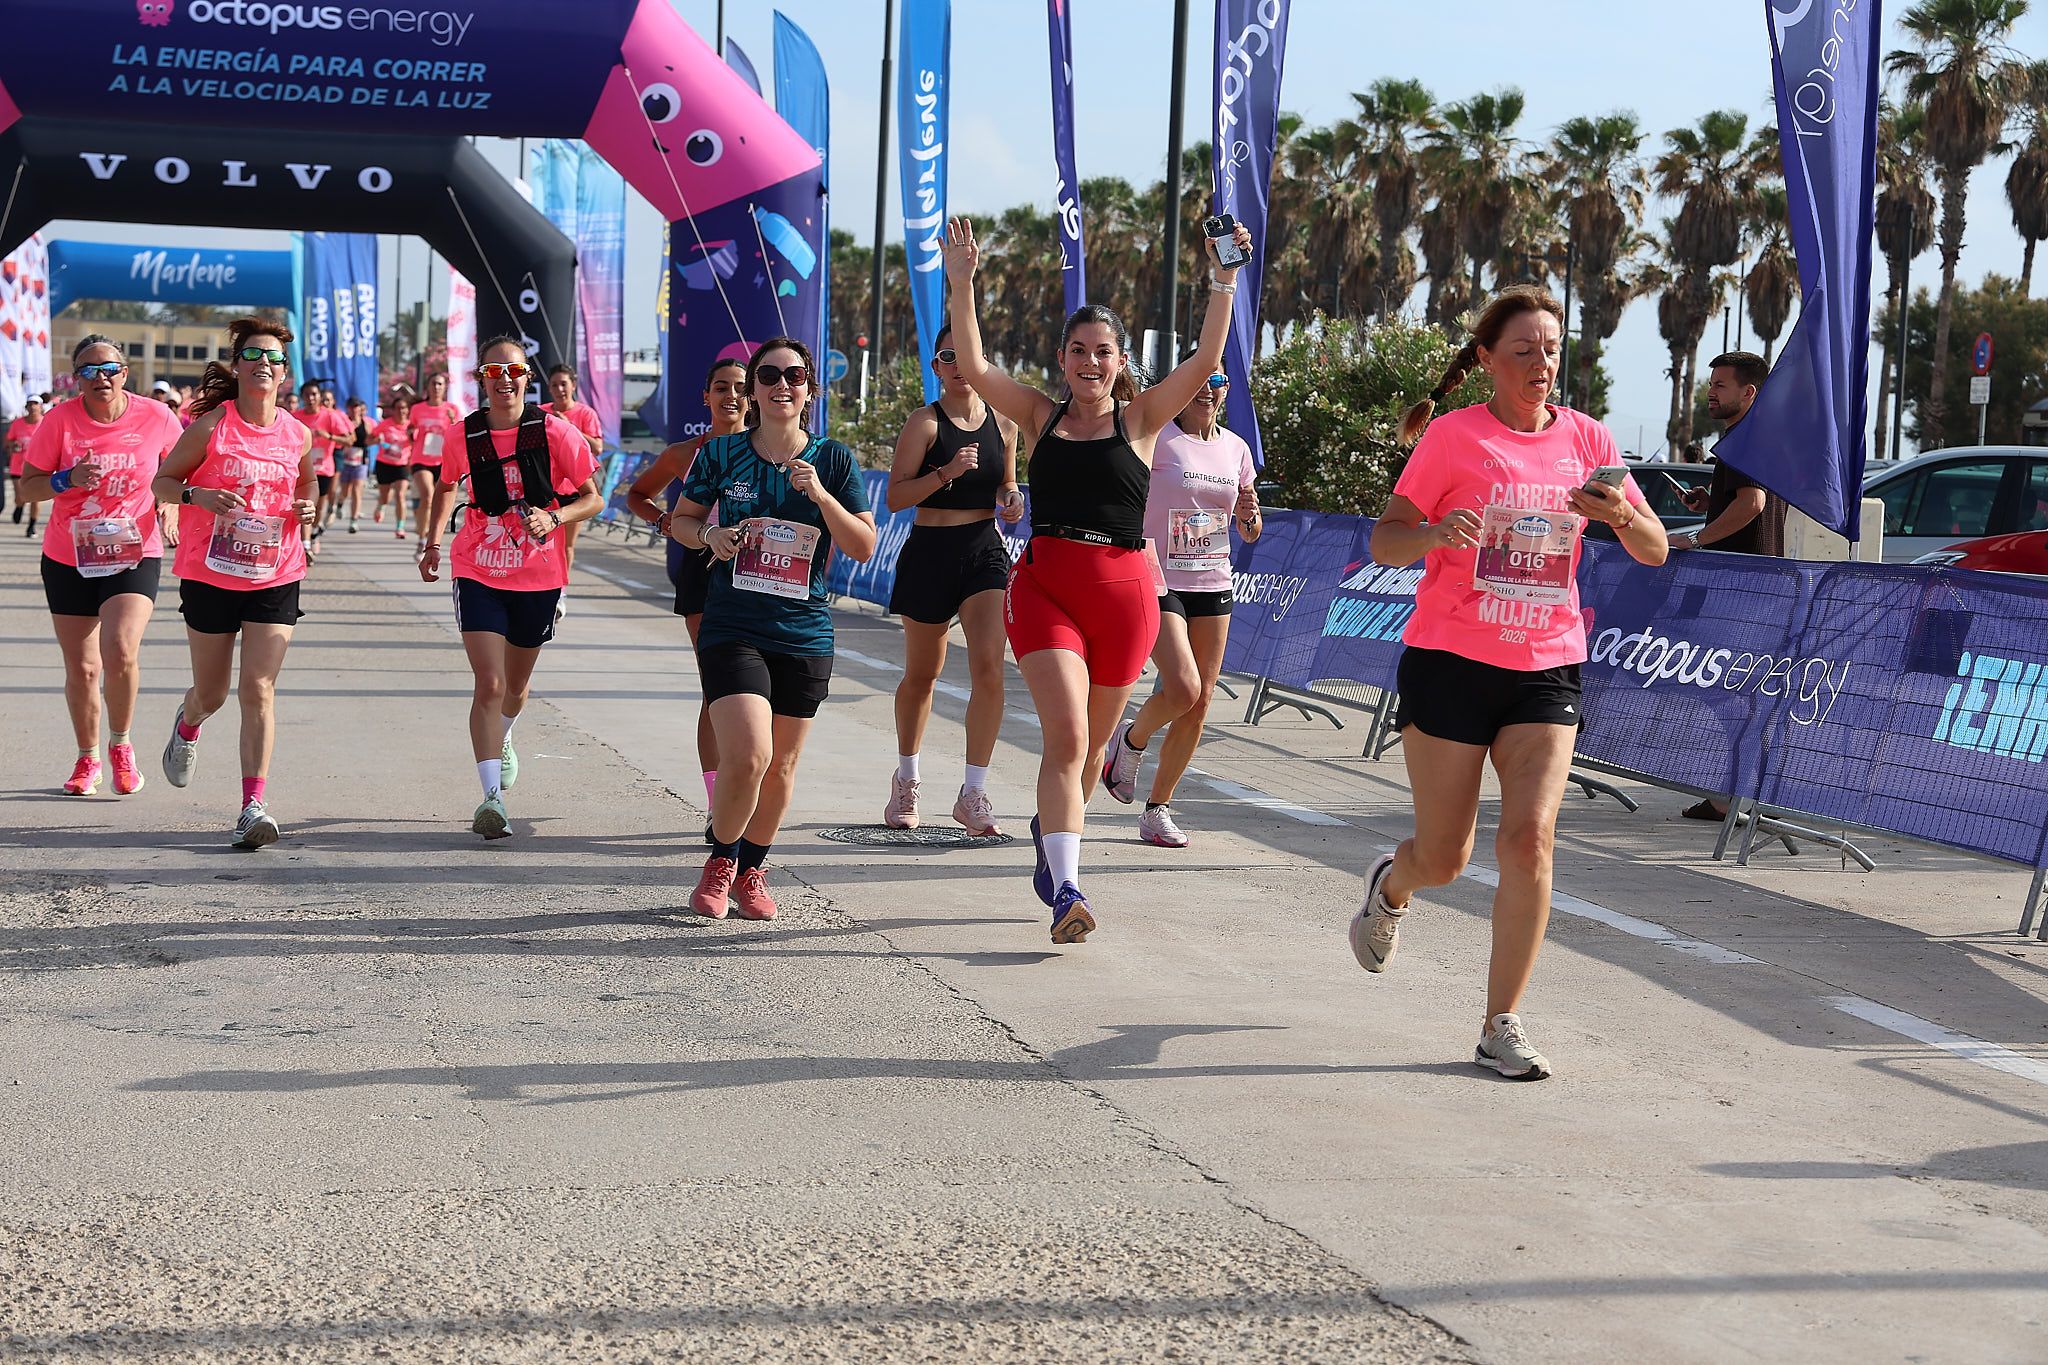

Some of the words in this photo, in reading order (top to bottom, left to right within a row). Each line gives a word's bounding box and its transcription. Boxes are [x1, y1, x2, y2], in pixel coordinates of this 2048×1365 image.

[188, 0, 343, 35] octopus
[346, 7, 474, 46] energy
[112, 44, 148, 65] LA
[156, 47, 280, 73] ENERGÍA
[288, 54, 365, 77] PARA
[373, 58, 487, 82] CORRER
[108, 74, 128, 92] A
[136, 75, 172, 95] LA
[182, 78, 344, 104] VELOCIDAD
[351, 87, 388, 105] DE
[394, 89, 429, 107] LA
[437, 91, 491, 109] LUZ
[80, 152, 393, 193] VOLVO
[130, 250, 236, 295] Marlene
[223, 458, 284, 481] CARRERA
[1484, 459, 1524, 470] OYSHO
[1183, 471, 1235, 487] CUATRECASAS
[1490, 482, 1572, 512] CARRER
[1084, 533, 1112, 544] KIPRUN
[1190, 537, 1210, 548] 016
[97, 544, 123, 555] 016
[233, 541, 261, 555] 016
[475, 549, 523, 568] MUJER
[760, 552, 791, 568] 016
[1510, 551, 1546, 569] 016
[740, 578, 765, 588] OYSHO
[1485, 574, 1506, 582] CARRERA
[1534, 591, 1560, 599] Santander
[1478, 597, 1554, 630] MUJER
[1499, 627, 1527, 644] 2026
[1591, 626, 1732, 688] octopus
[1723, 652, 1851, 728] energy
